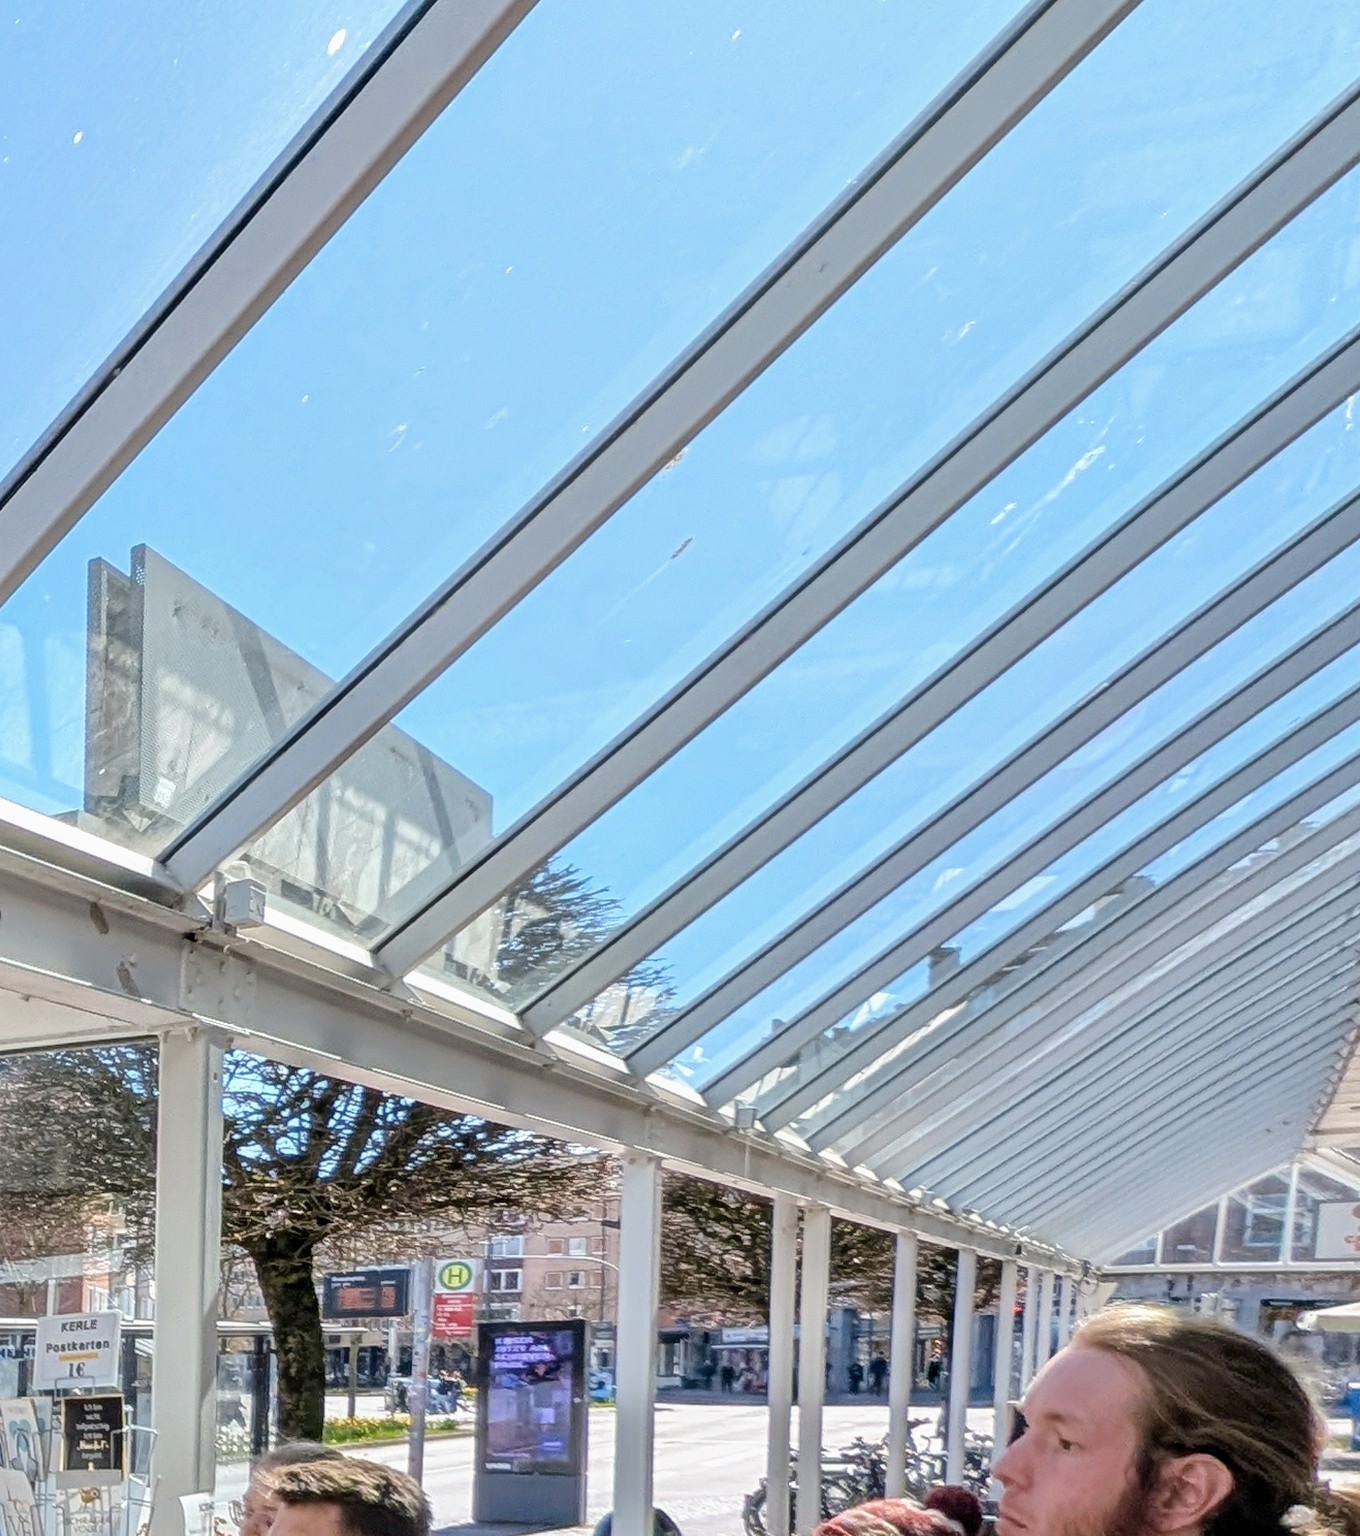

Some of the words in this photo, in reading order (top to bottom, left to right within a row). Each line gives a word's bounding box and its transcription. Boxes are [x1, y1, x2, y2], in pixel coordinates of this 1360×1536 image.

[448, 1267, 462, 1285] H
[60, 1320, 98, 1333] KERLE
[46, 1340, 110, 1354] Postkarten
[68, 1362, 86, 1377] 1€
